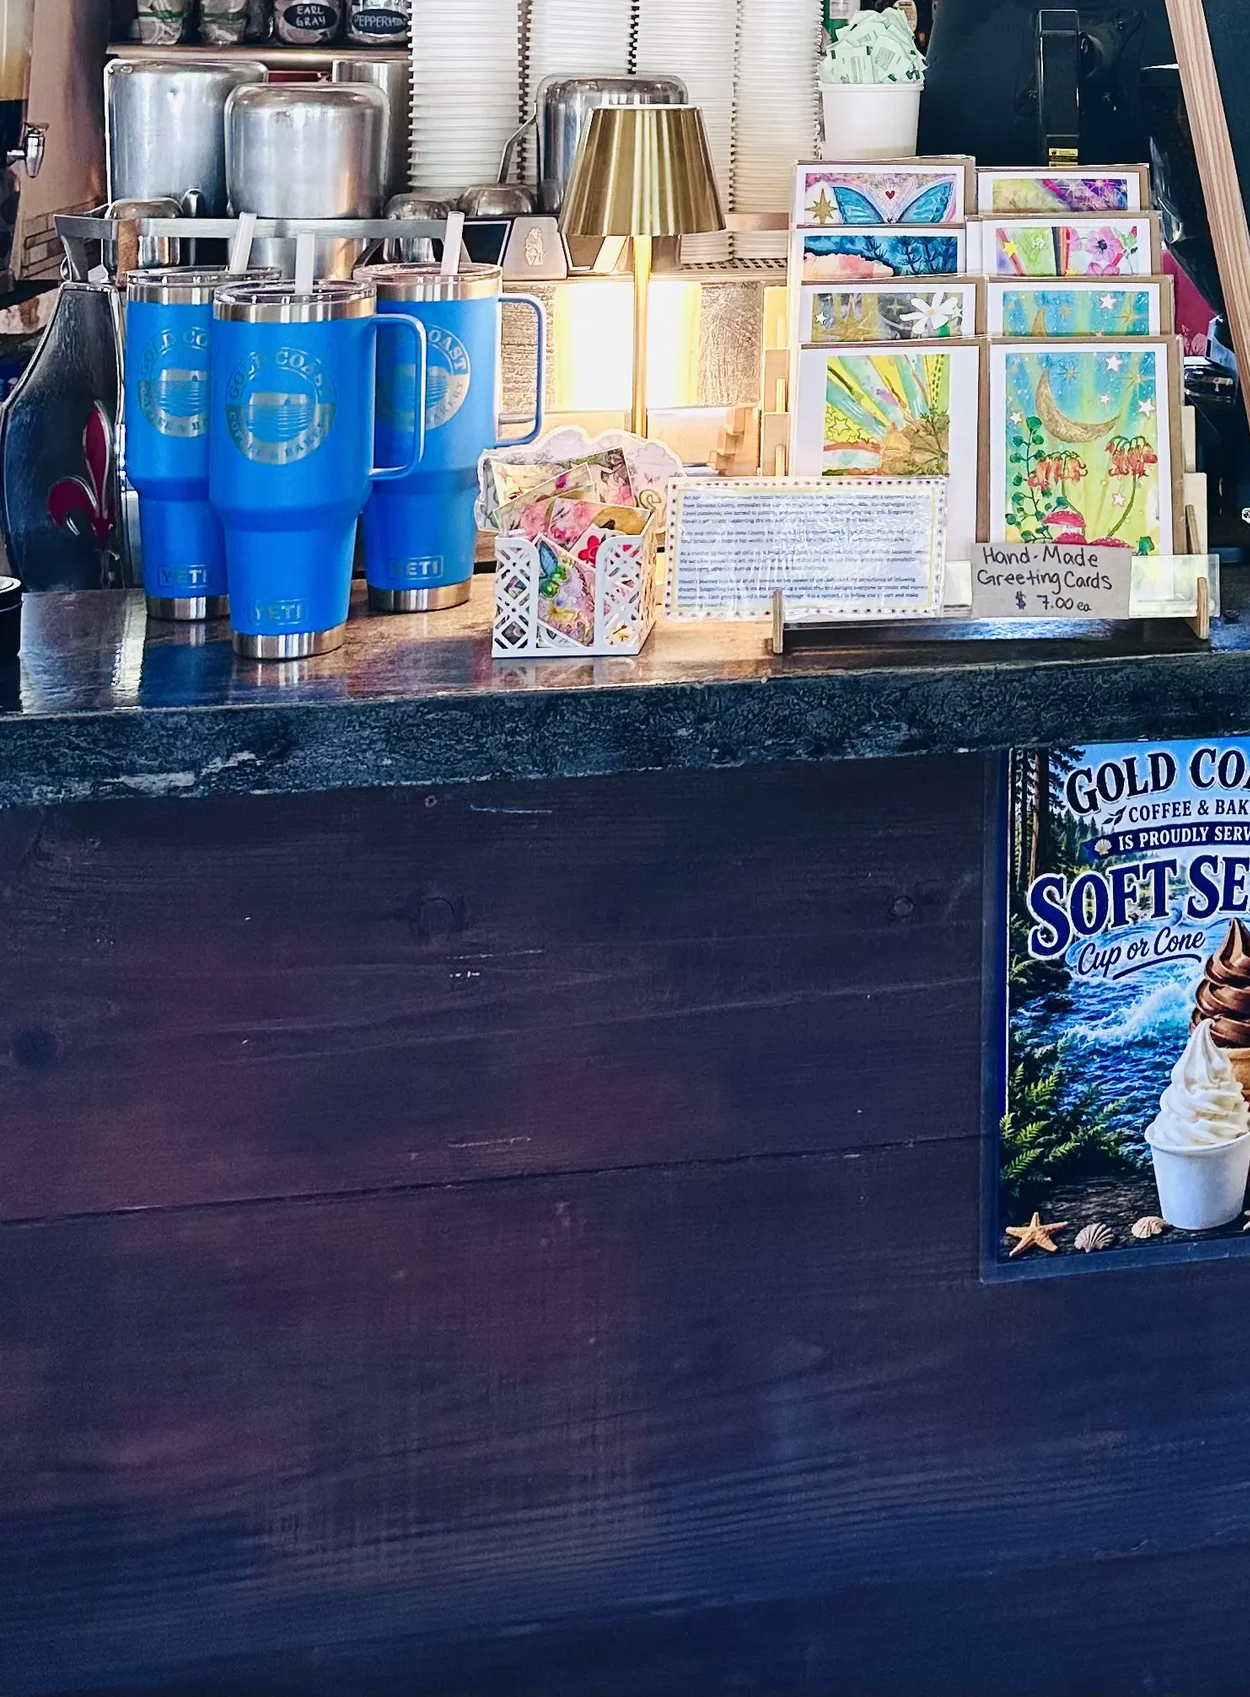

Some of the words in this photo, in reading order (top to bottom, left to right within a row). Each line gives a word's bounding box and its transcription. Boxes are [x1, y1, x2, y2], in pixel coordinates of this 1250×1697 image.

[296, 5, 324, 15] EARL
[981, 545, 1098, 568] Hand-Made
[977, 570, 1062, 593] Greeting
[1063, 572, 1113, 590] Cards
[254, 603, 301, 622] YETI
[1036, 595, 1074, 610] 7.00
[1077, 601, 1092, 612] ea
[1065, 751, 1176, 815] GOLD
[1129, 800, 1192, 823] COFFEE
[1198, 799, 1210, 815] &
[1118, 835, 1134, 850] IS
[1139, 826, 1209, 849] PROUDLY
[1029, 857, 1179, 957] SOFT
[1078, 941, 1119, 977] Cup
[1127, 938, 1150, 961] or
[1154, 927, 1206, 957] Cone
